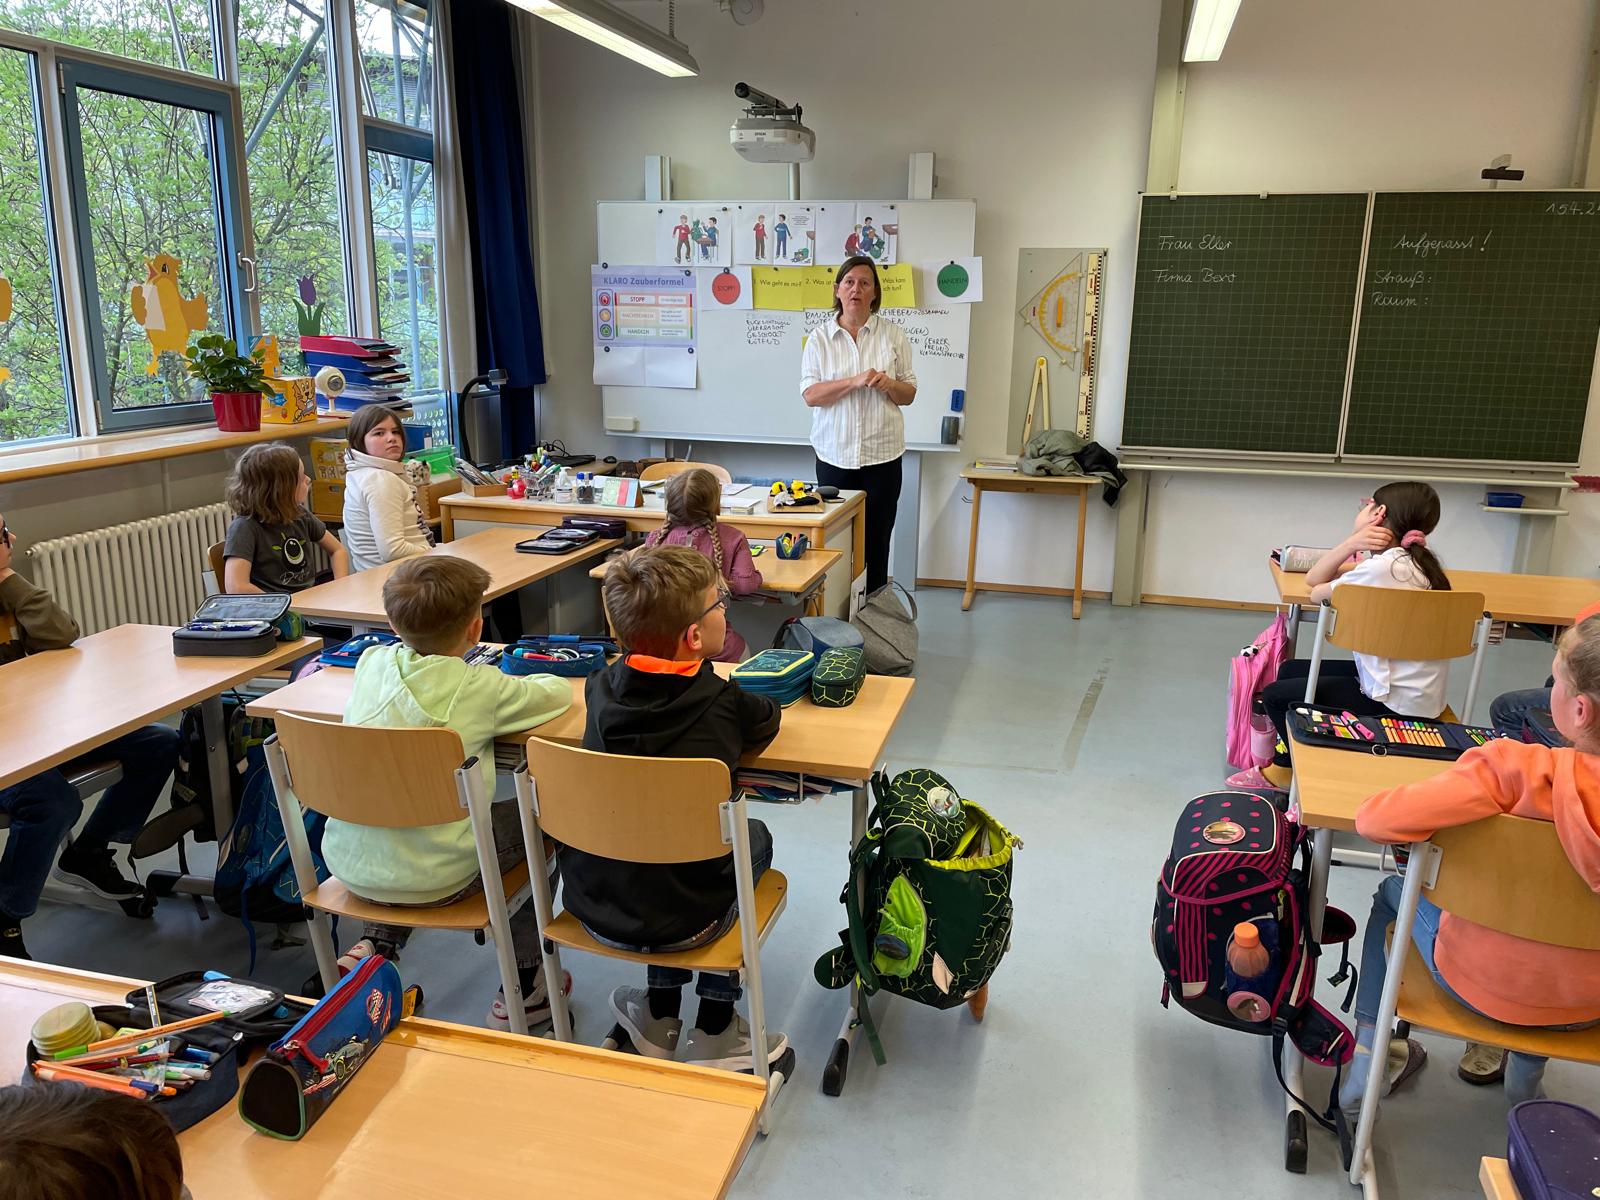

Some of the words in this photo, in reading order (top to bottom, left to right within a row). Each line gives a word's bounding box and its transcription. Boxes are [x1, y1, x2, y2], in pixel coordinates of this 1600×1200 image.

[1159, 235, 1192, 251] Frau
[1394, 232, 1474, 258] Aufgepasst
[603, 277, 628, 285] KLARO
[630, 277, 684, 286] Zauberformel
[1152, 264, 1193, 283] Firma
